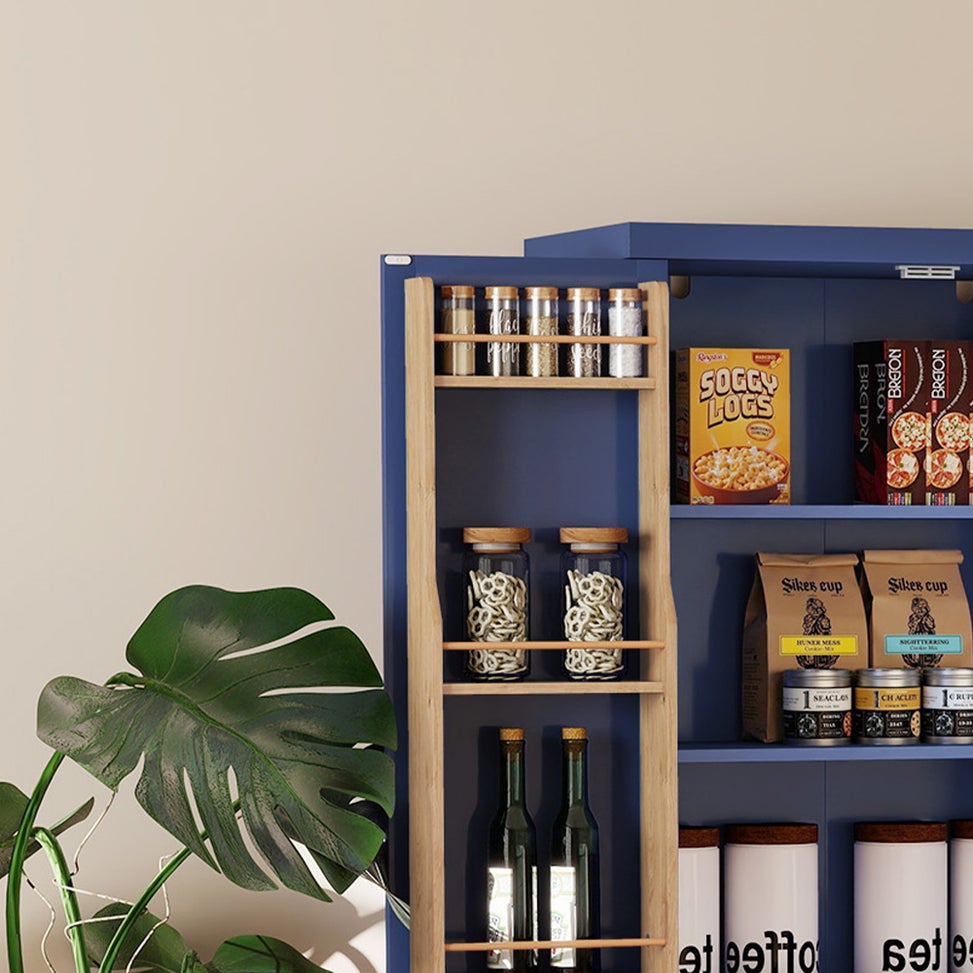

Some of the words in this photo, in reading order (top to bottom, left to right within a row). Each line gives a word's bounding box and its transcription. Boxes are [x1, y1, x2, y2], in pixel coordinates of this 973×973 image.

[700, 367, 779, 402] SOGGY
[708, 394, 774, 428] LOGS
[820, 581, 843, 594] cup
[925, 581, 948, 594] cup
